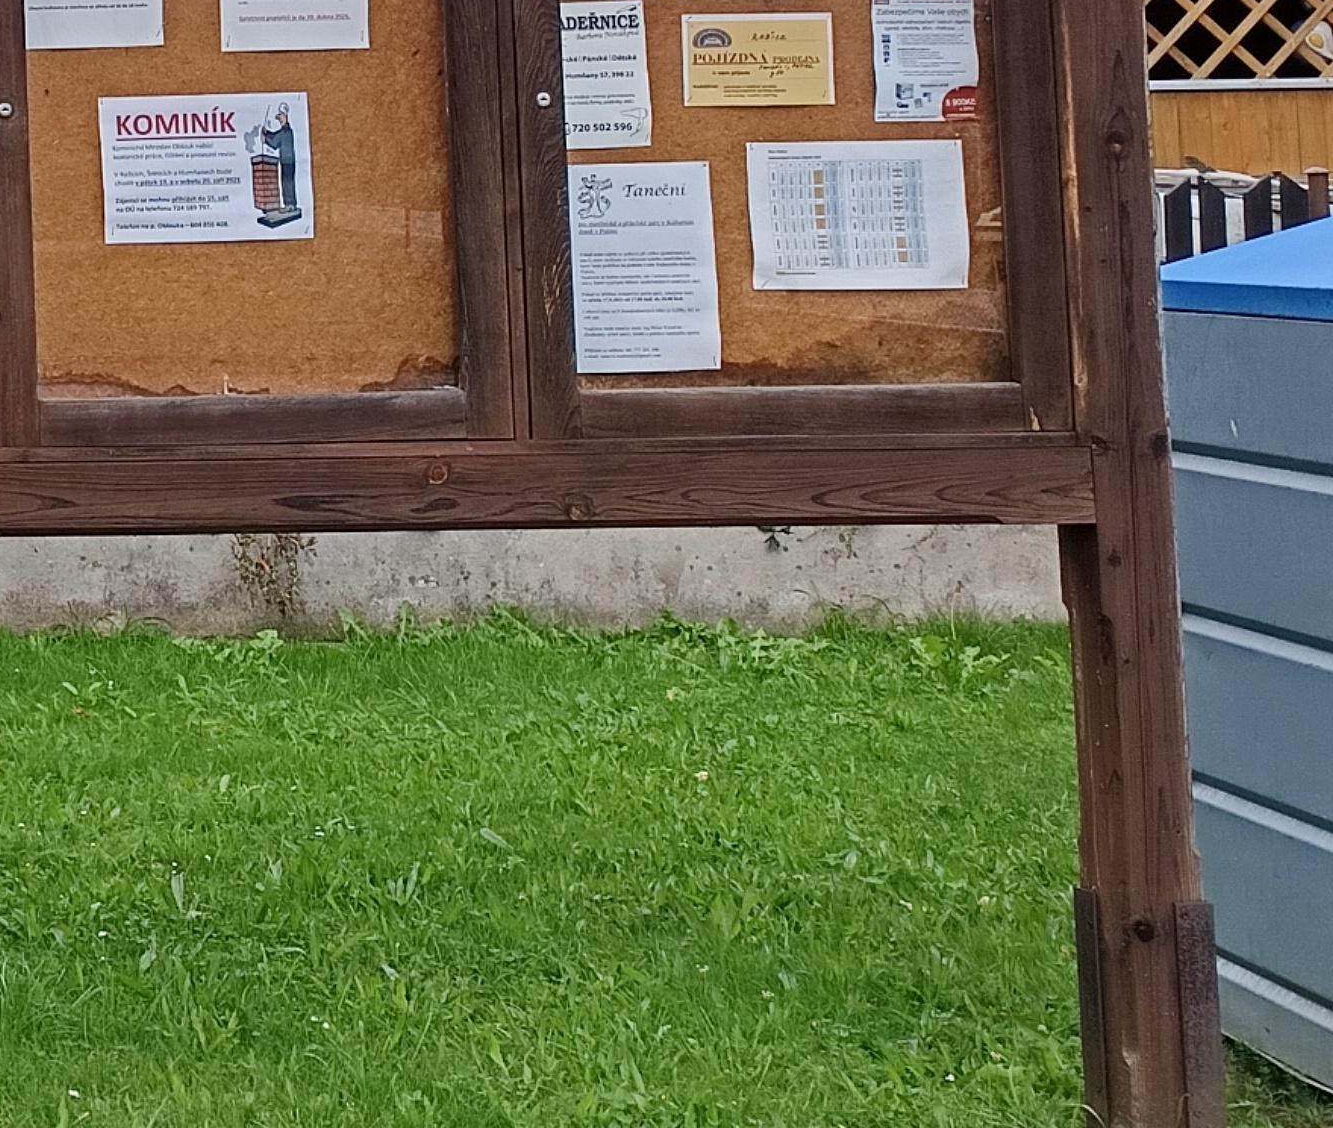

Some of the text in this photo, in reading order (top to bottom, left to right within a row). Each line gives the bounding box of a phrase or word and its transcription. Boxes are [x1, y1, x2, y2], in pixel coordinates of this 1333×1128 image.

[693, 50, 820, 65] POJÍZDNÁ PRODEJNA
[116, 105, 236, 136] KOMINÍK
[572, 122, 633, 132] 720 502 596
[622, 183, 686, 198] Taneční
